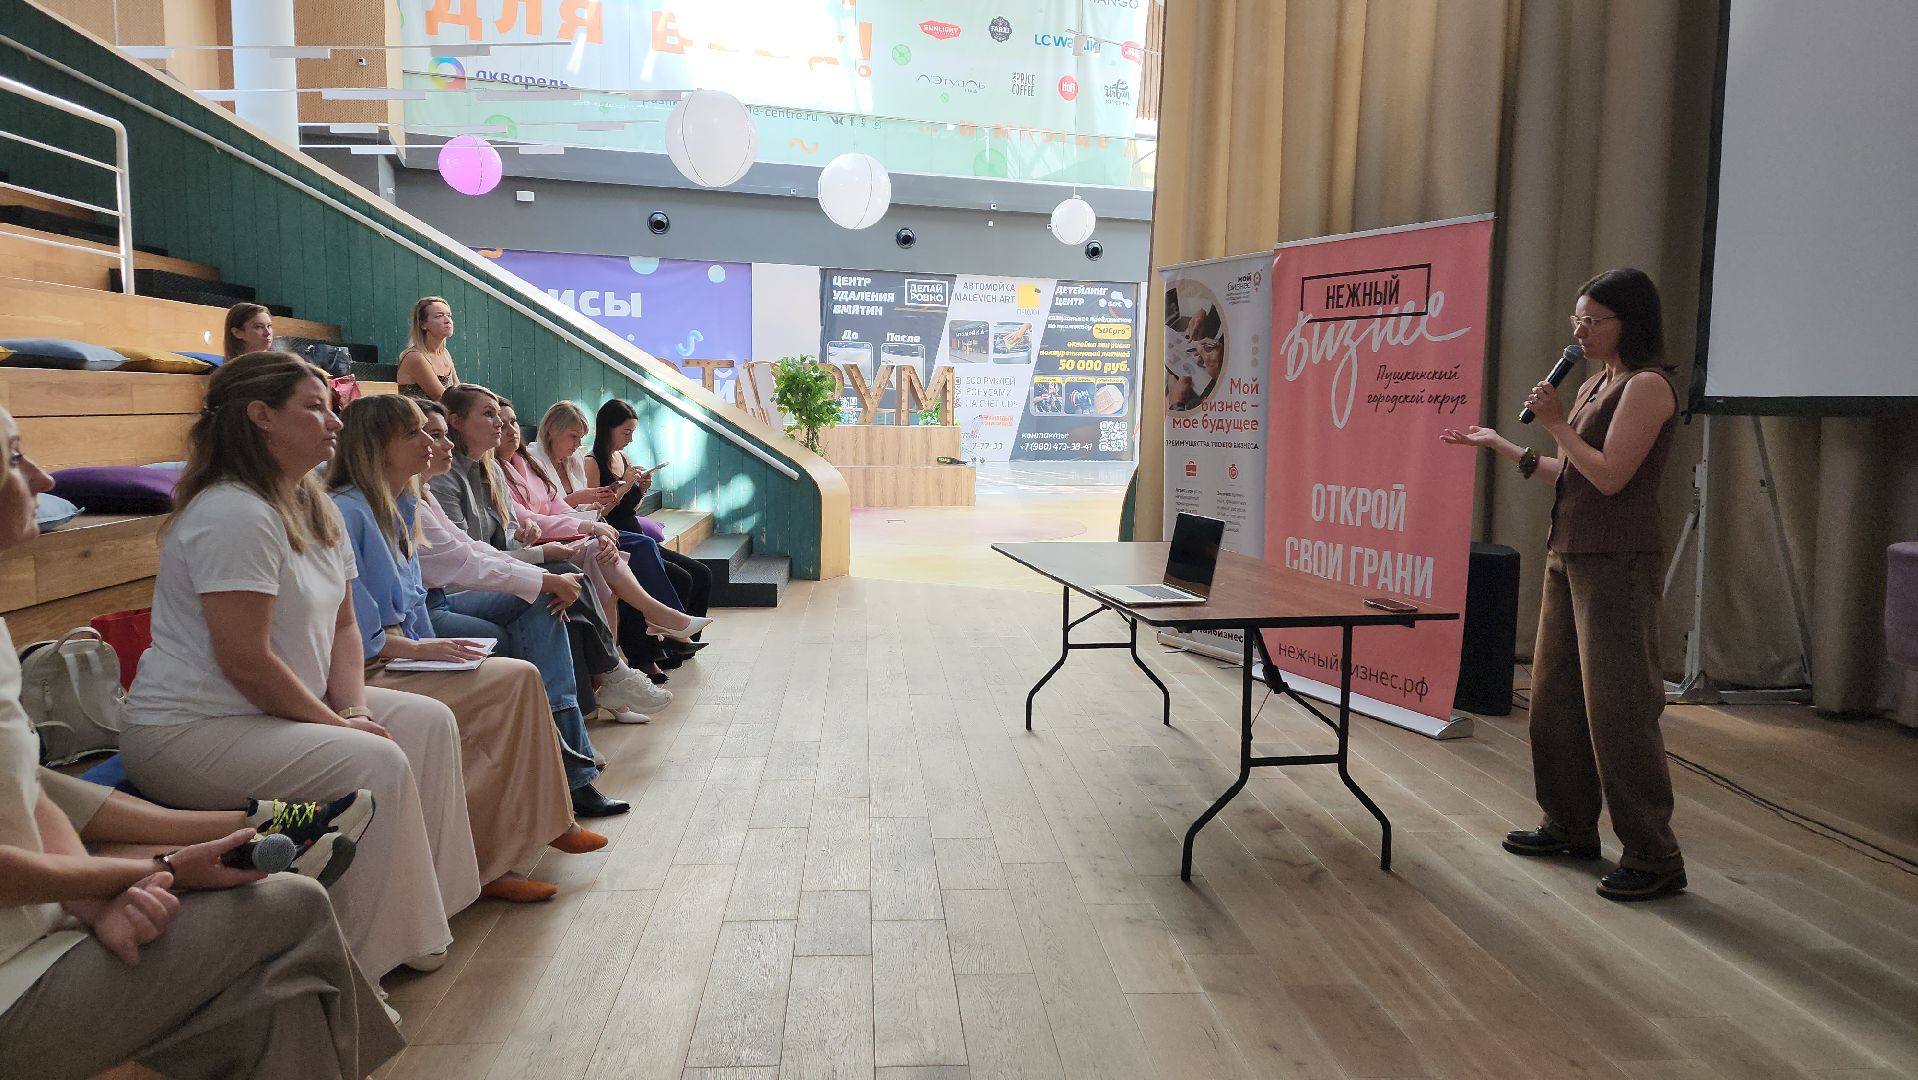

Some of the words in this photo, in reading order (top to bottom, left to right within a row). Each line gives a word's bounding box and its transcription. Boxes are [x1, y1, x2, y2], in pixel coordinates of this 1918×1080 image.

[923, 24, 959, 33] SUNLIGHT
[1034, 34, 1052, 46] LC
[1017, 72, 1035, 85] PRICE
[1011, 84, 1035, 97] COFFEE
[832, 275, 872, 288] ЦЕНТР
[962, 281, 1016, 293] АВТОМОЙКА
[909, 283, 943, 294] ДЕЛАЙ
[1054, 285, 1109, 296] ДЕТЕЙЛИНГ
[1325, 273, 1400, 310] НЕЖНЫЙ
[832, 289, 895, 303] УДАЛЕНИЯ
[910, 293, 944, 302] РОВНО
[954, 293, 997, 304] MALEVICH
[999, 295, 1016, 304] ART
[1054, 297, 1085, 307] ЦЕНТР
[832, 304, 883, 316] ВМЯТИН
[841, 329, 859, 341] До
[886, 331, 921, 343] После
[1058, 359, 1075, 371] 50
[1077, 359, 1102, 371] 000
[1103, 360, 1130, 374] руб.
[1376, 364, 1461, 390] Пушкинский
[1229, 377, 1259, 395] Мой
[1201, 398, 1247, 413] бизнес
[1366, 388, 1426, 414] городской
[1426, 392, 1468, 414] округ
[1172, 417, 1199, 429] мое
[1201, 413, 1259, 434] будущее
[1311, 483, 1407, 532] ОТКРОЙ
[1285, 536, 1343, 582] СВОИ
[1350, 546, 1434, 599] ГРАНИ
[1278, 642, 1430, 702] нежныйизнес.рф
